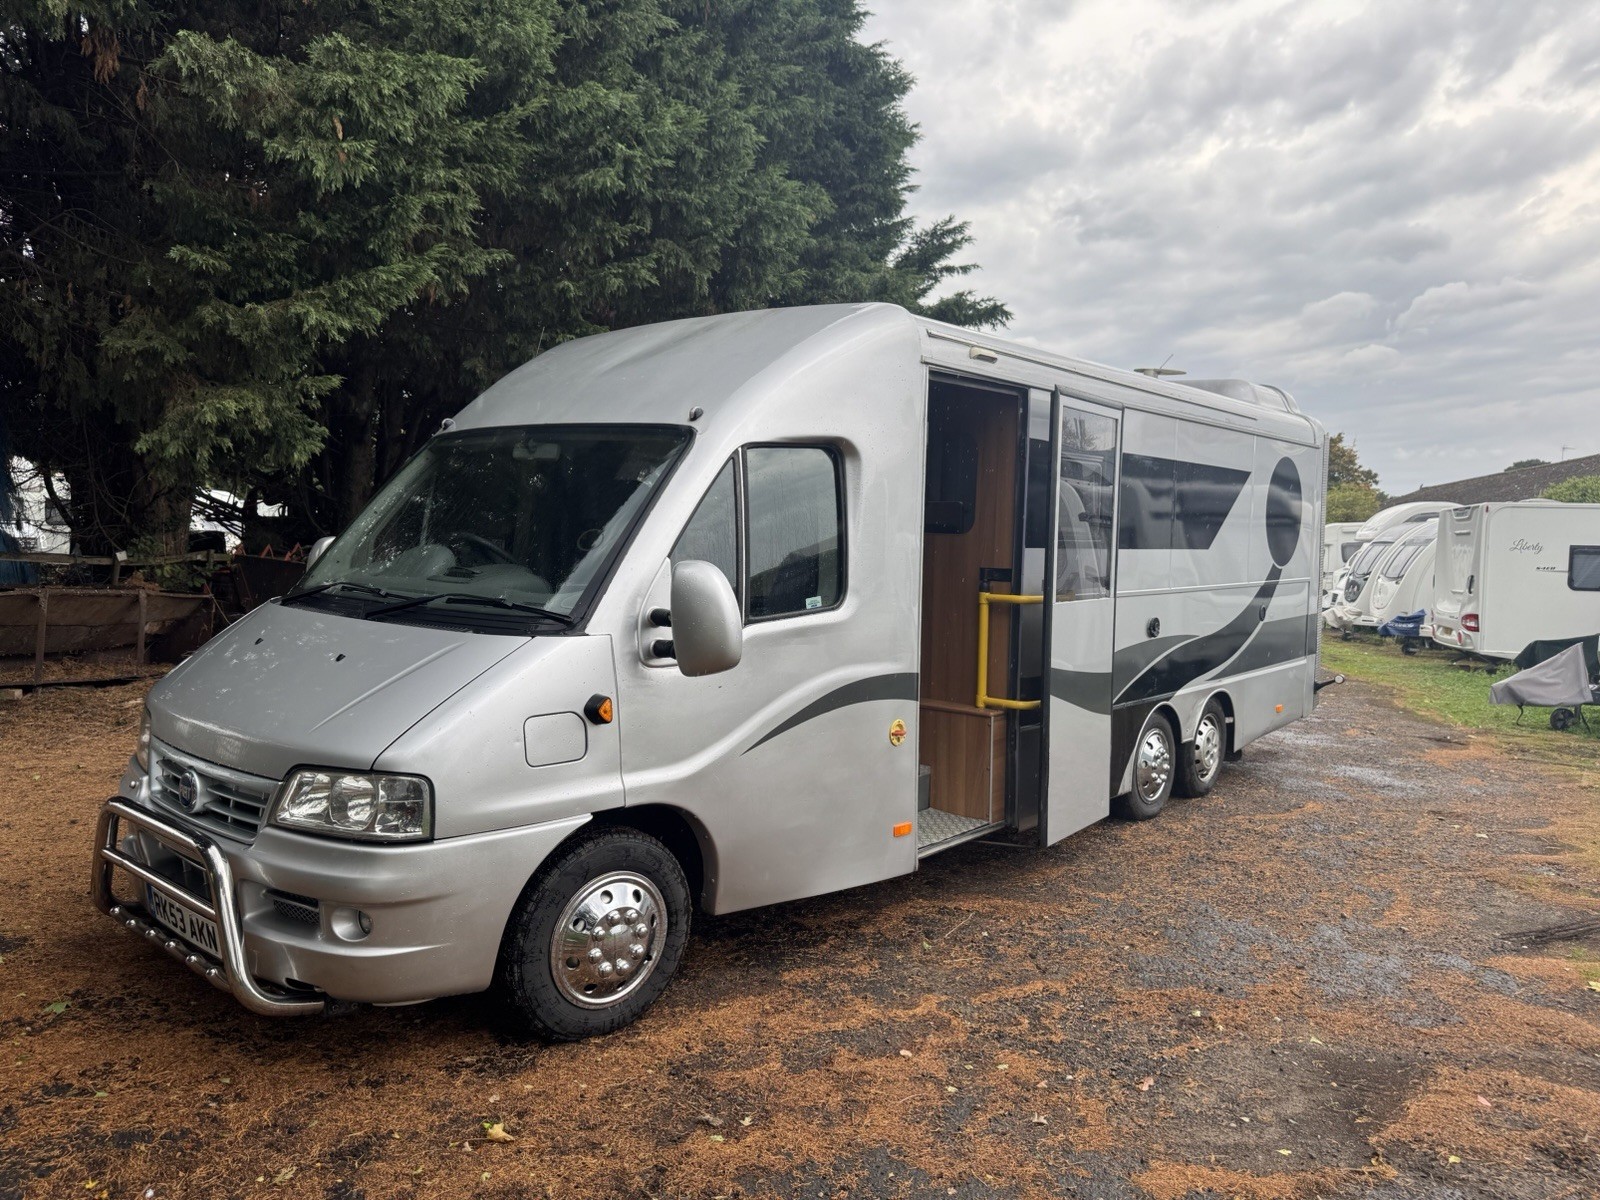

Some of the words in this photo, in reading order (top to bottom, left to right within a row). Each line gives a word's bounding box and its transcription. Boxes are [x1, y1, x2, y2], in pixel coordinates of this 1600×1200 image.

[1509, 538, 1544, 555] Liberty
[152, 891, 187, 934] RK53
[189, 913, 219, 953] AKN
